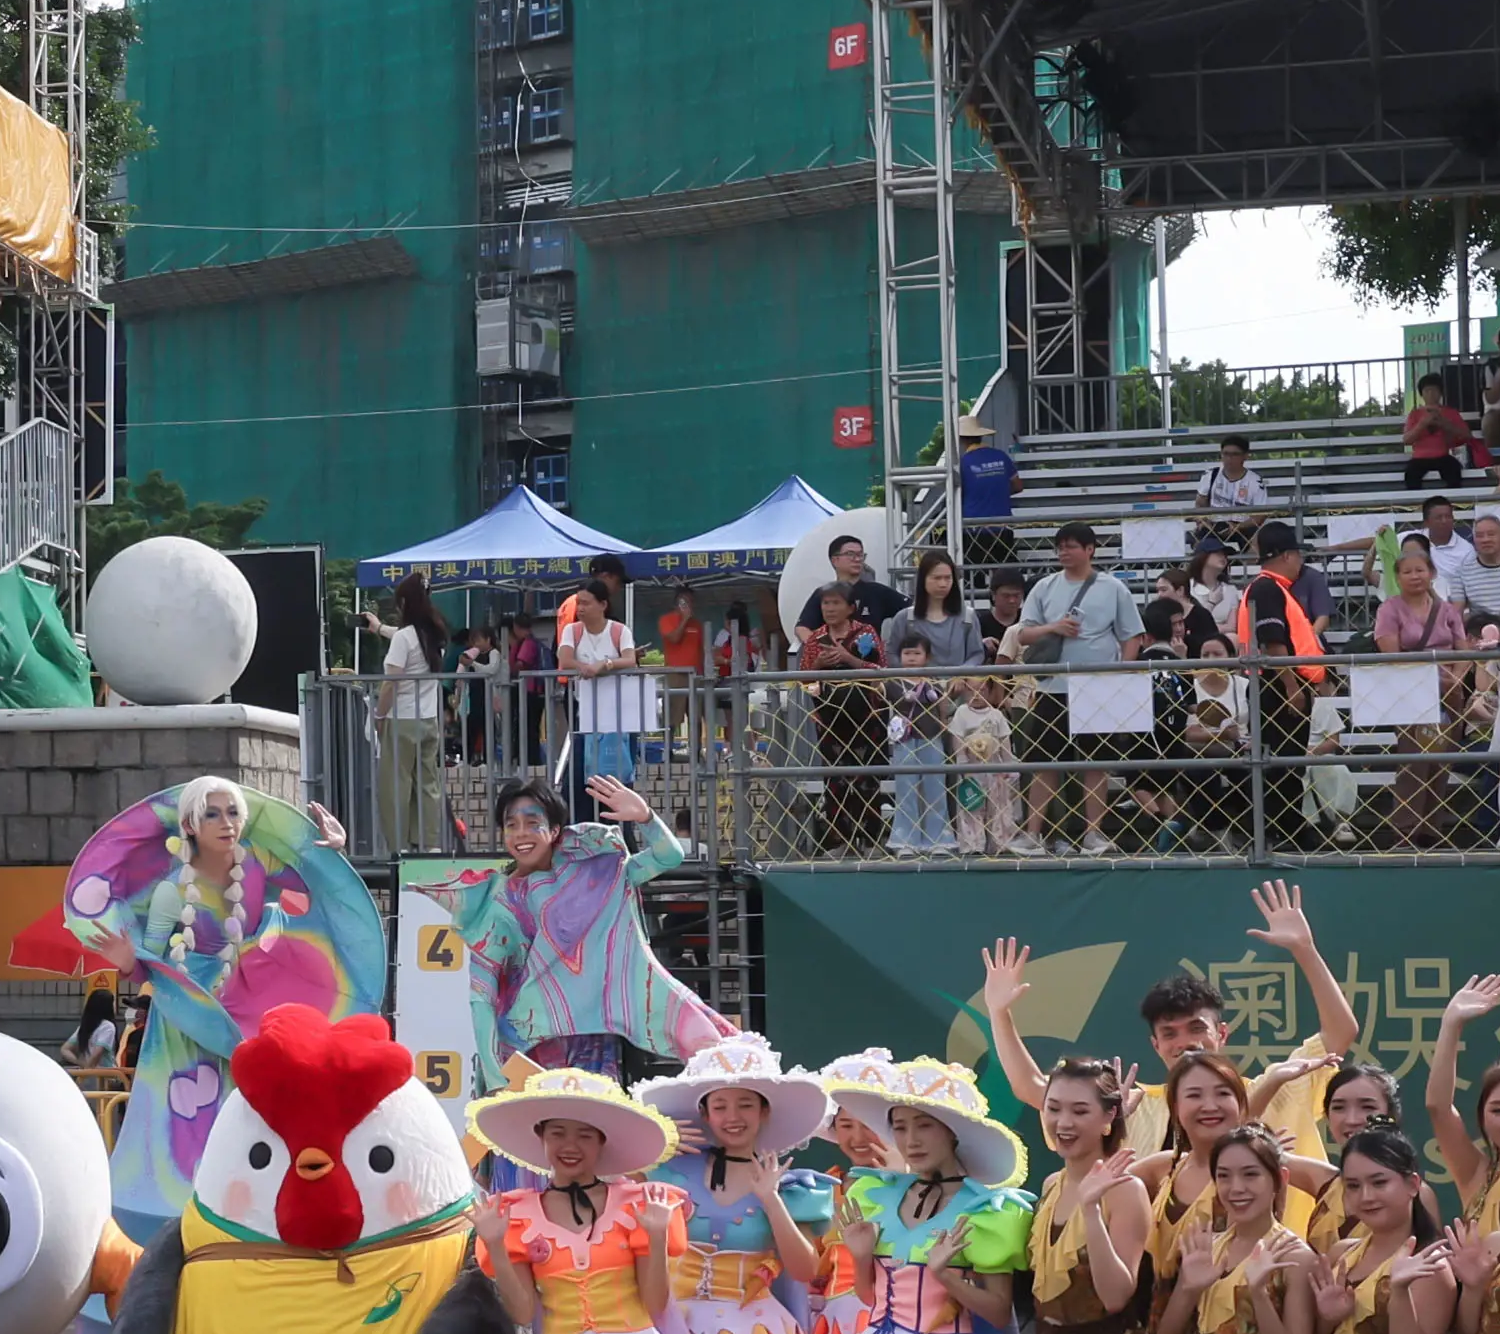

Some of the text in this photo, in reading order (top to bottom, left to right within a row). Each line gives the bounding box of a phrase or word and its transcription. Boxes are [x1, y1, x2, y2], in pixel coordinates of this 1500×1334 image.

[834, 34, 858, 57] 6F
[839, 417, 865, 437] 3F
[426, 928, 454, 967] 4
[426, 1055, 451, 1094] 5
